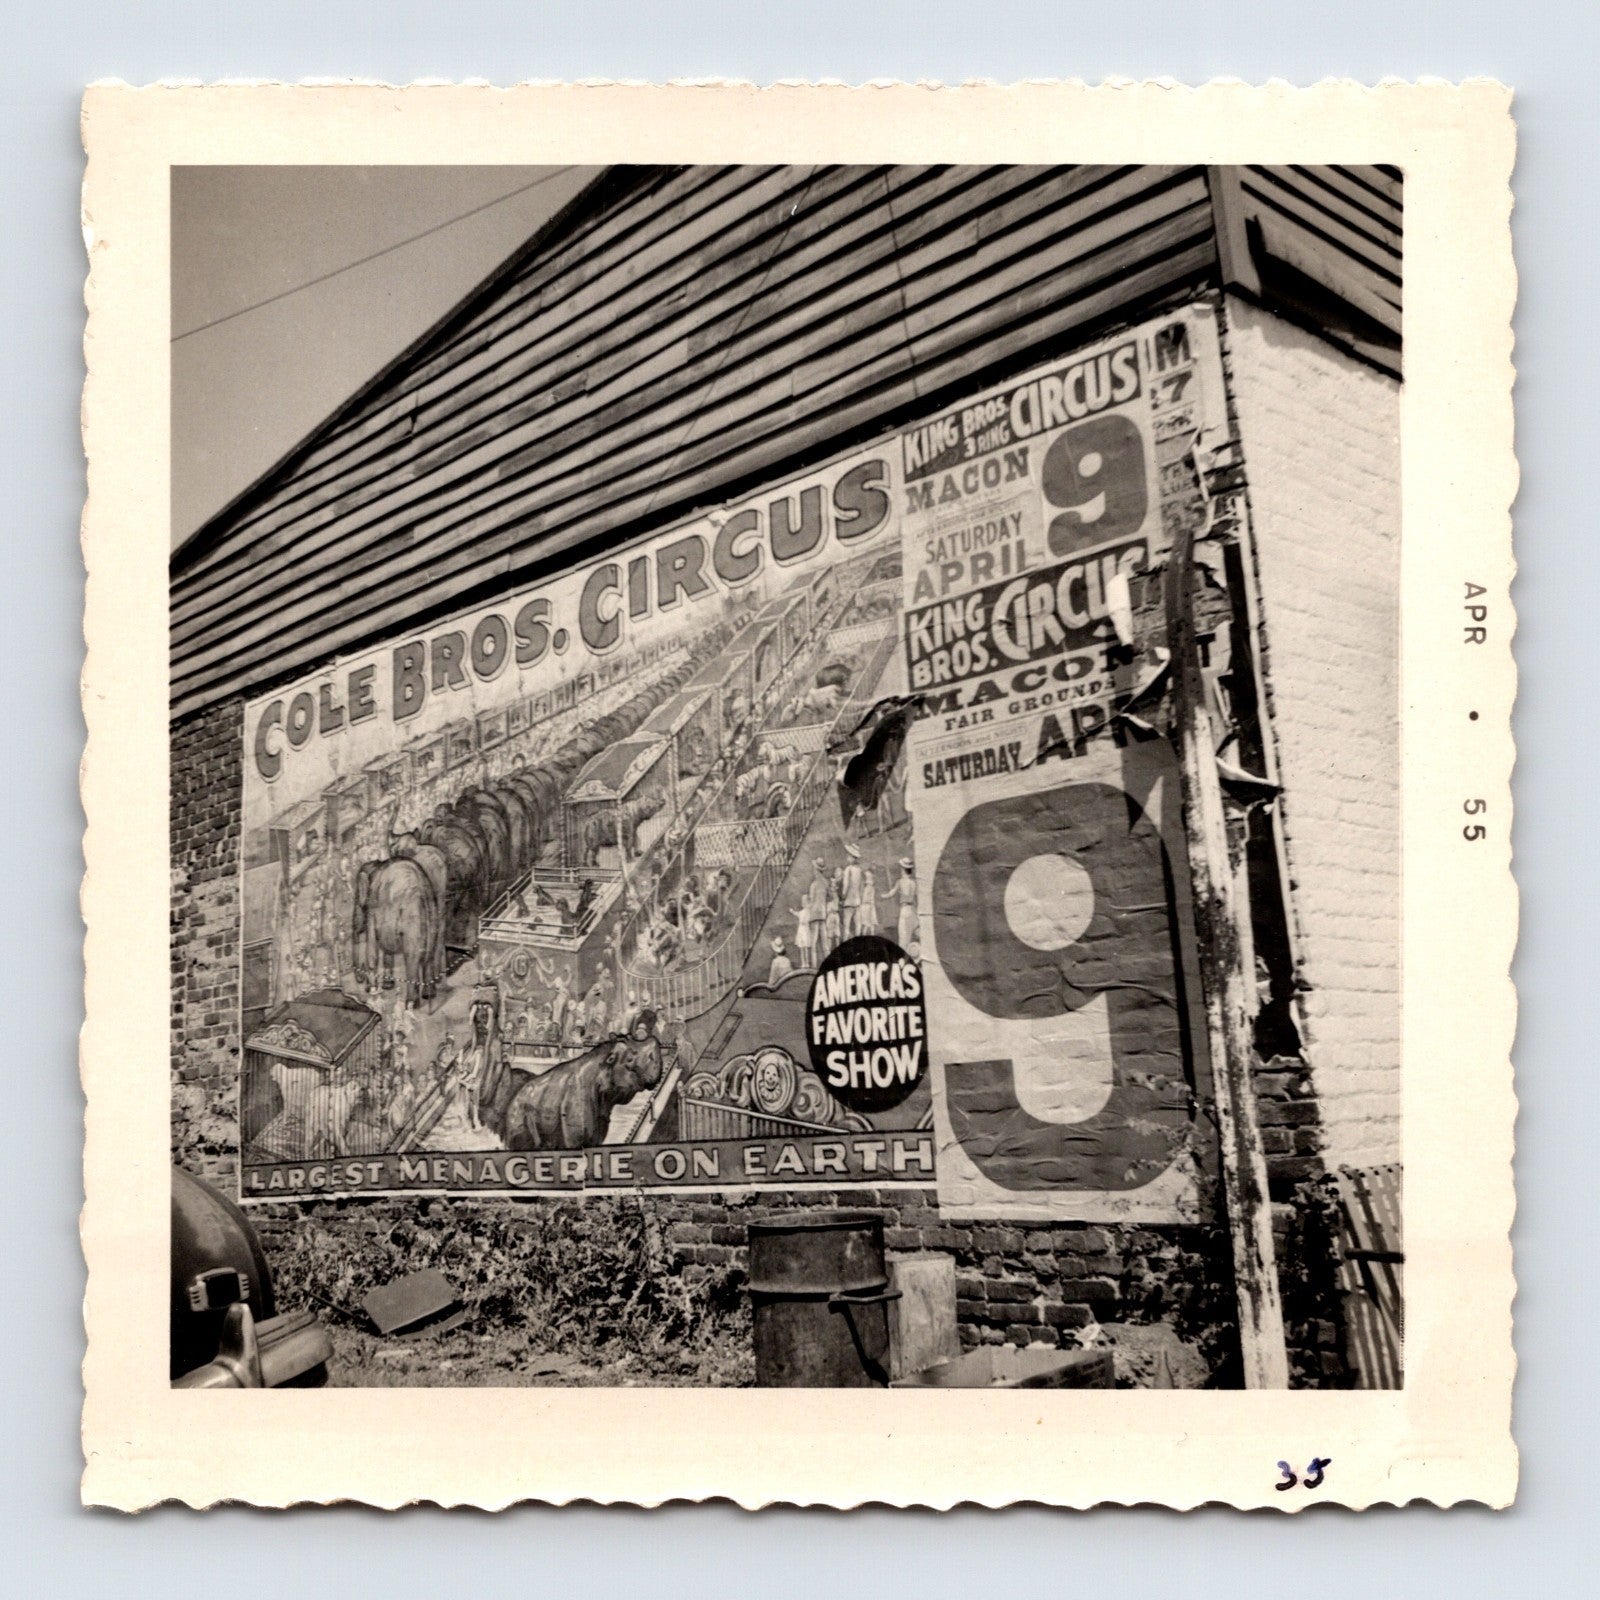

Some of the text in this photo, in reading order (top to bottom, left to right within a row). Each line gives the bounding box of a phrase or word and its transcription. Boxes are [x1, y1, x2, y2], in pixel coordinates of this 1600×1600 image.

[904, 414, 959, 475] KING
[1010, 338, 1140, 439] CIRCUS
[963, 420, 1010, 458] 3 RING
[905, 446, 1030, 515] MACON
[1042, 414, 1149, 558] 9
[925, 511, 1022, 565] SATURDAY
[912, 539, 1030, 602] APRIL
[254, 459, 892, 784] COLE BROS. CIRCUS
[909, 591, 986, 660] KING
[912, 630, 998, 690] BROS.
[944, 675, 1116, 731] FAIR GROUNDS
[1462, 581, 1488, 842] APR 55
[923, 741, 1021, 788] SATURDAY
[813, 957, 921, 1012] AMERICA'S
[932, 782, 1194, 1191] 9
[812, 1003, 923, 1046] FAVORITE
[826, 1041, 922, 1090] SHOW
[250, 1137, 935, 1193] LARGEST MENAGERIE ON EARTH
[1275, 1458, 1332, 1491] 35
